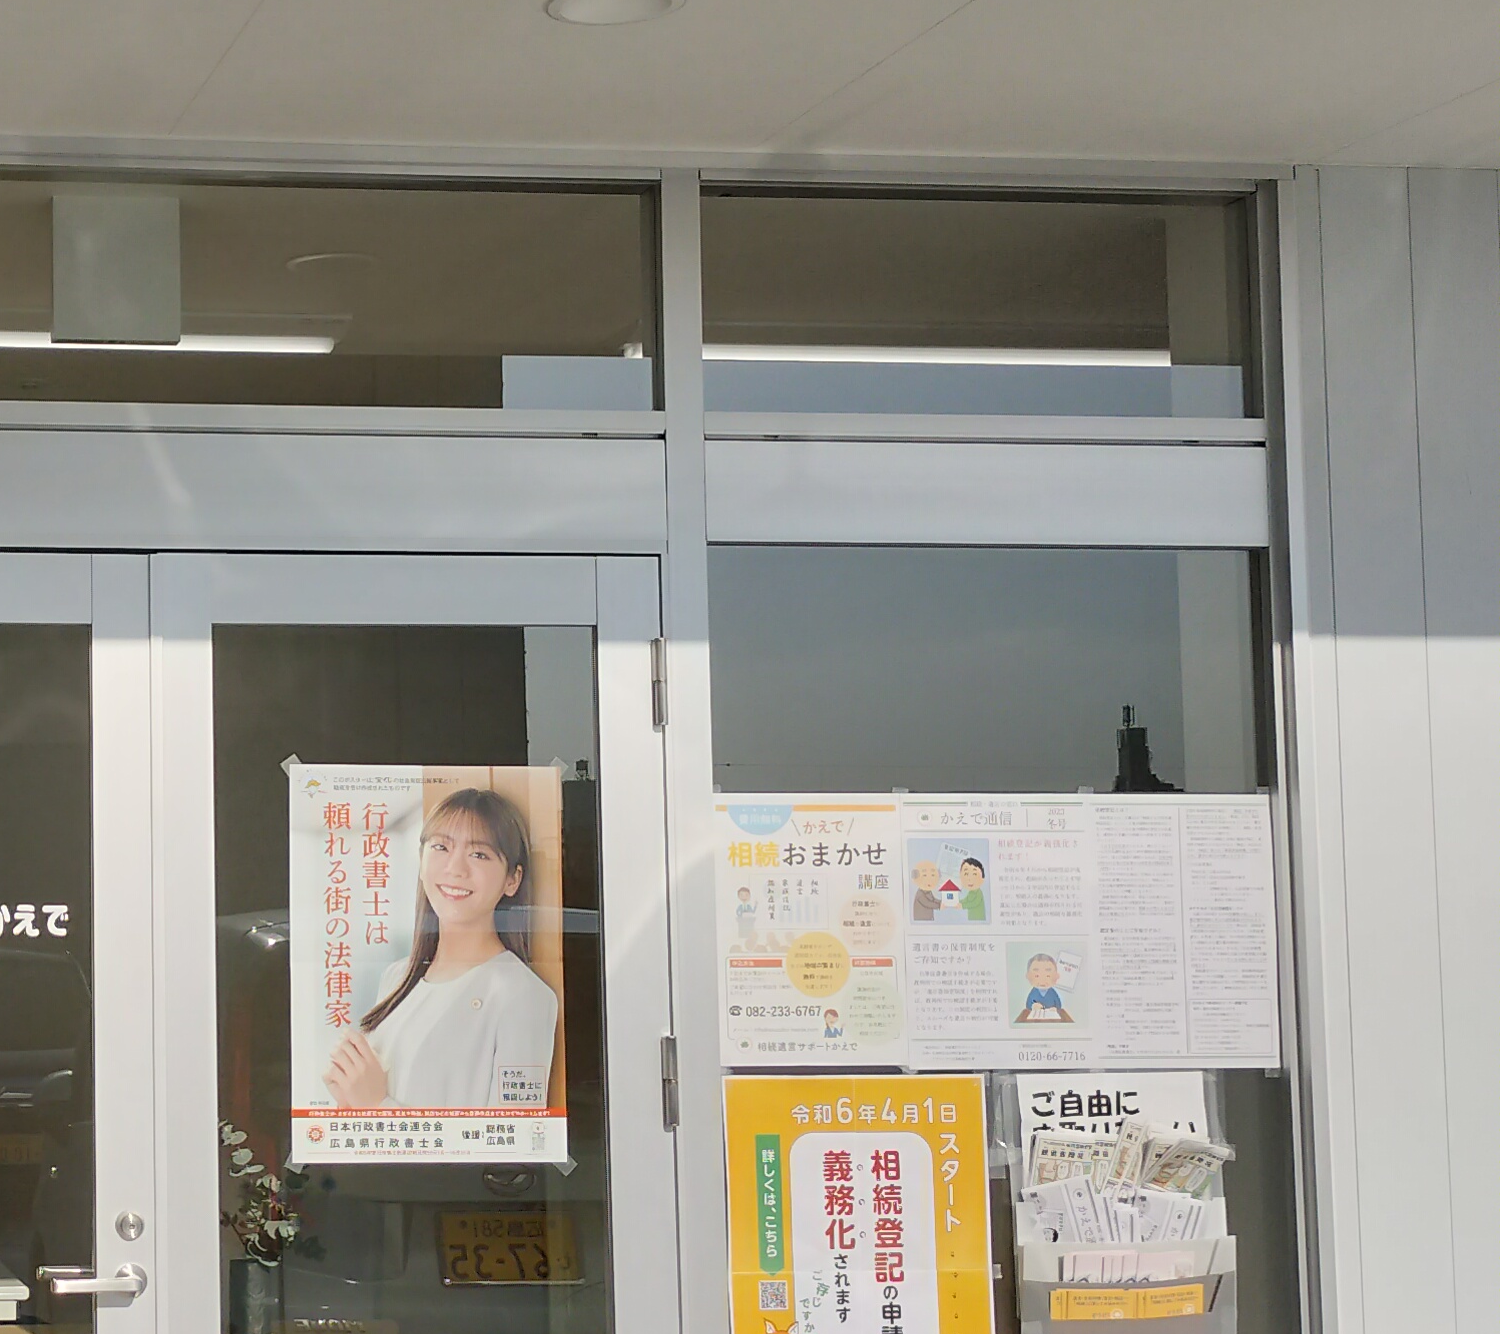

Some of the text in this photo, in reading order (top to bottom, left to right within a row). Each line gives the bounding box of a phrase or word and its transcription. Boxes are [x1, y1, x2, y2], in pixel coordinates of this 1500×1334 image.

[802, 820, 844, 835] かえで
[940, 810, 1013, 826] かえで通信
[728, 841, 887, 867] 相続おまかせ
[362, 802, 390, 946] 行政書士は
[858, 874, 889, 890] 講座
[323, 802, 353, 1028] 頼れる街の法律家
[746, 1006, 822, 1017] 082-233-6767
[790, 1096, 958, 1125] 令和6年4月1日
[1031, 1089, 1140, 1117] ご自由に
[329, 1121, 444, 1132] 日本行政書士会連合会
[329, 1137, 444, 1148] 広島県行政書士会
[938, 1132, 962, 1233] スタート
[761, 1148, 778, 1258] 詳しくは、こちら
[822, 1149, 857, 1324] 義務化されます
